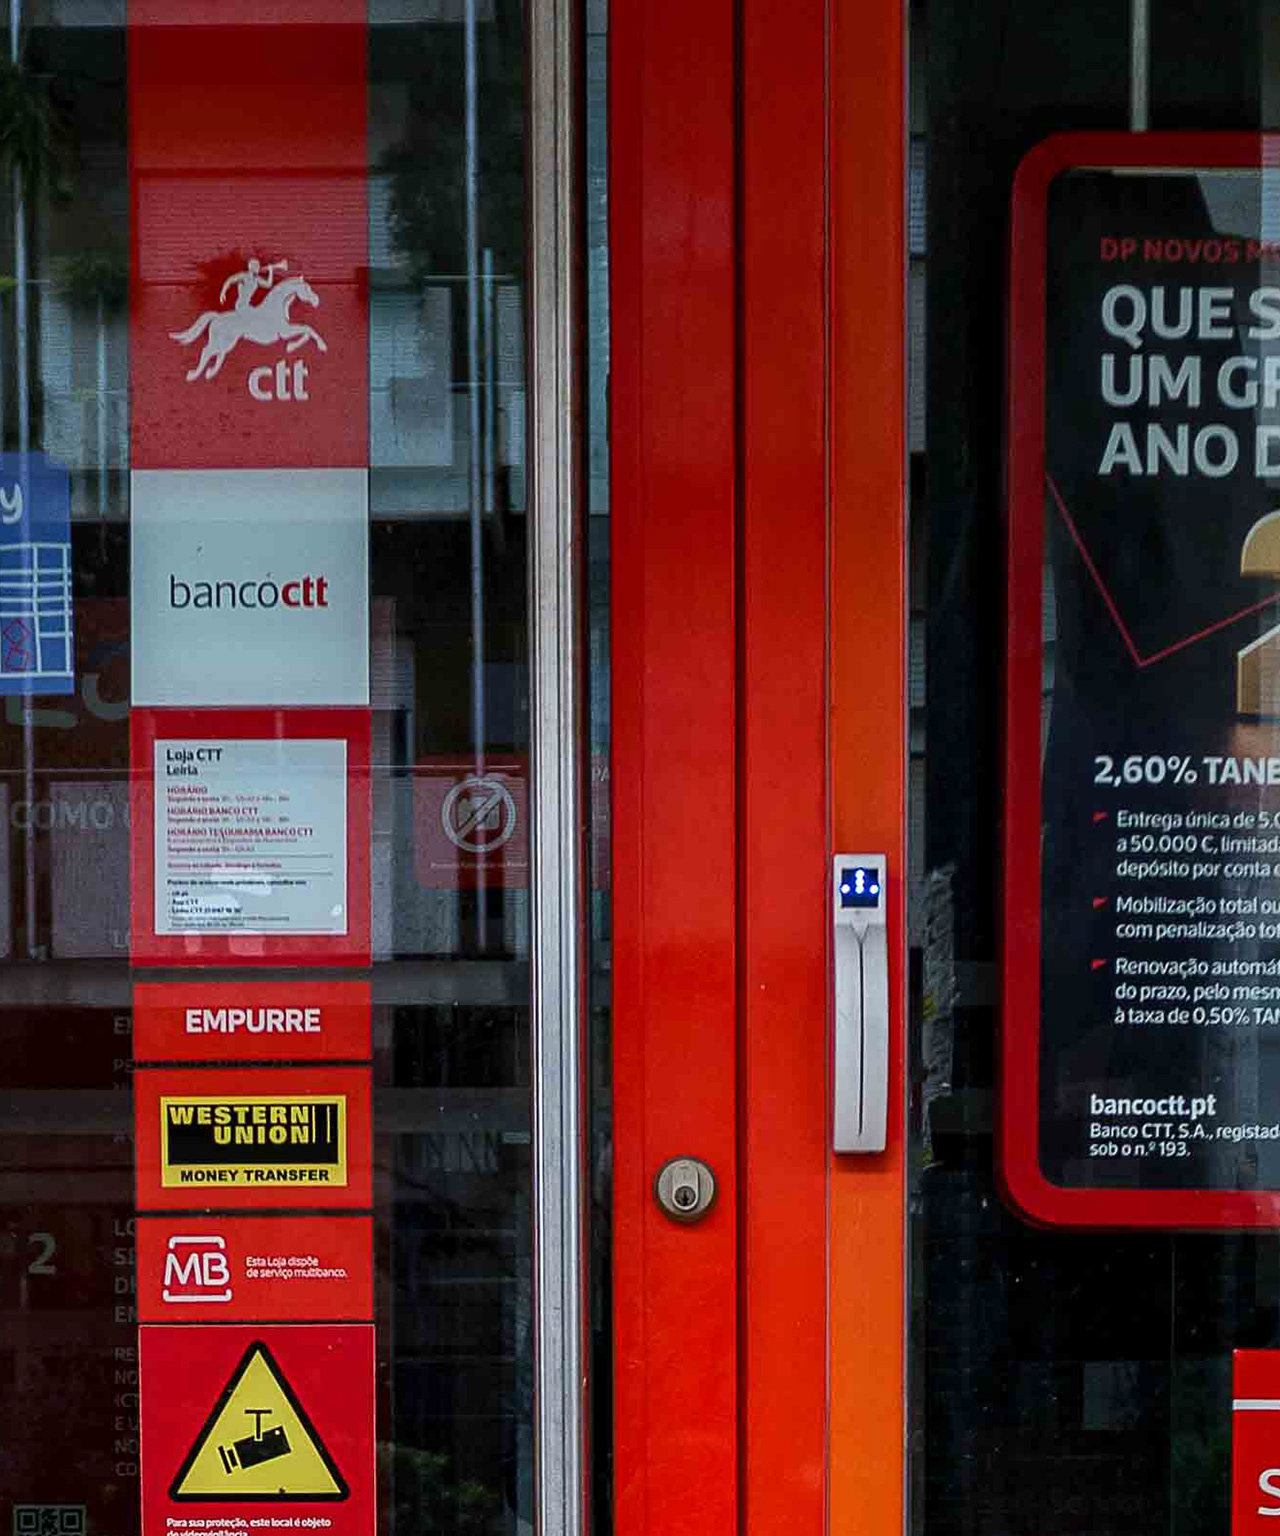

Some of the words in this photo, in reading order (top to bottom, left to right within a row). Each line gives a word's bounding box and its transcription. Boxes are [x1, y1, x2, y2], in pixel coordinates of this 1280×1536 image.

[1100, 238, 1136, 263] DP
[1143, 239, 1240, 263] NOVOS
[1101, 284, 1234, 347] QUE
[248, 359, 309, 400] ctt
[1101, 353, 1200, 408] UM
[1097, 424, 1239, 478] ANO
[170, 573, 328, 608] bancoctt
[167, 749, 193, 764] Loja
[197, 748, 222, 761] CTT
[167, 765, 198, 776] Leiria
[1093, 756, 1197, 786] 2,60%
[1117, 811, 1182, 831] Entrega
[1186, 812, 1230, 828] única
[1233, 812, 1255, 828] de
[1117, 839, 1126, 852] a
[1130, 835, 1197, 852] 50.000
[1117, 860, 1189, 881] depósito
[1193, 864, 1219, 879] por
[1223, 862, 1270, 877] conta
[1117, 897, 1216, 917] Mobilização
[1220, 897, 1257, 913] total
[1117, 925, 1153, 938] com
[1156, 922, 1256, 942] penalização
[1116, 959, 1208, 978] Renovação
[1115, 983, 1136, 999] do
[1140, 986, 1190, 1003] prazo,
[1194, 984, 1229, 1003] pelo
[186, 1008, 321, 1033] EMPURRE
[1115, 1008, 1125, 1024] à
[1128, 1009, 1164, 1023] taxa
[1168, 1008, 1190, 1023] de
[1193, 1007, 1249, 1026] 0,50%
[170, 1106, 308, 1125] WESTERN
[1090, 1094, 1217, 1120] bancoctt.pt
[214, 1125, 308, 1144] UNION
[1090, 1123, 1138, 1139] Banco
[1141, 1123, 1175, 1141] CTT,
[1090, 1141, 1117, 1156] sob
[1122, 1145, 1131, 1156] o
[181, 1169, 238, 1182] MONEY
[244, 1169, 329, 1181] TRANSFER
[27, 1232, 58, 1275] 2
[246, 1257, 266, 1267] Esta
[268, 1257, 286, 1268] Loja
[288, 1257, 319, 1268] dispõe
[164, 1252, 230, 1285] MB
[246, 1269, 259, 1277] de
[260, 1269, 293, 1279] serviço
[167, 1518, 187, 1527] Para
[189, 1519, 205, 1527] sua
[250, 1519, 270, 1527] este
[271, 1518, 293, 1527] local
[295, 1518, 300, 1527] é
[302, 1518, 331, 1529] objeto
